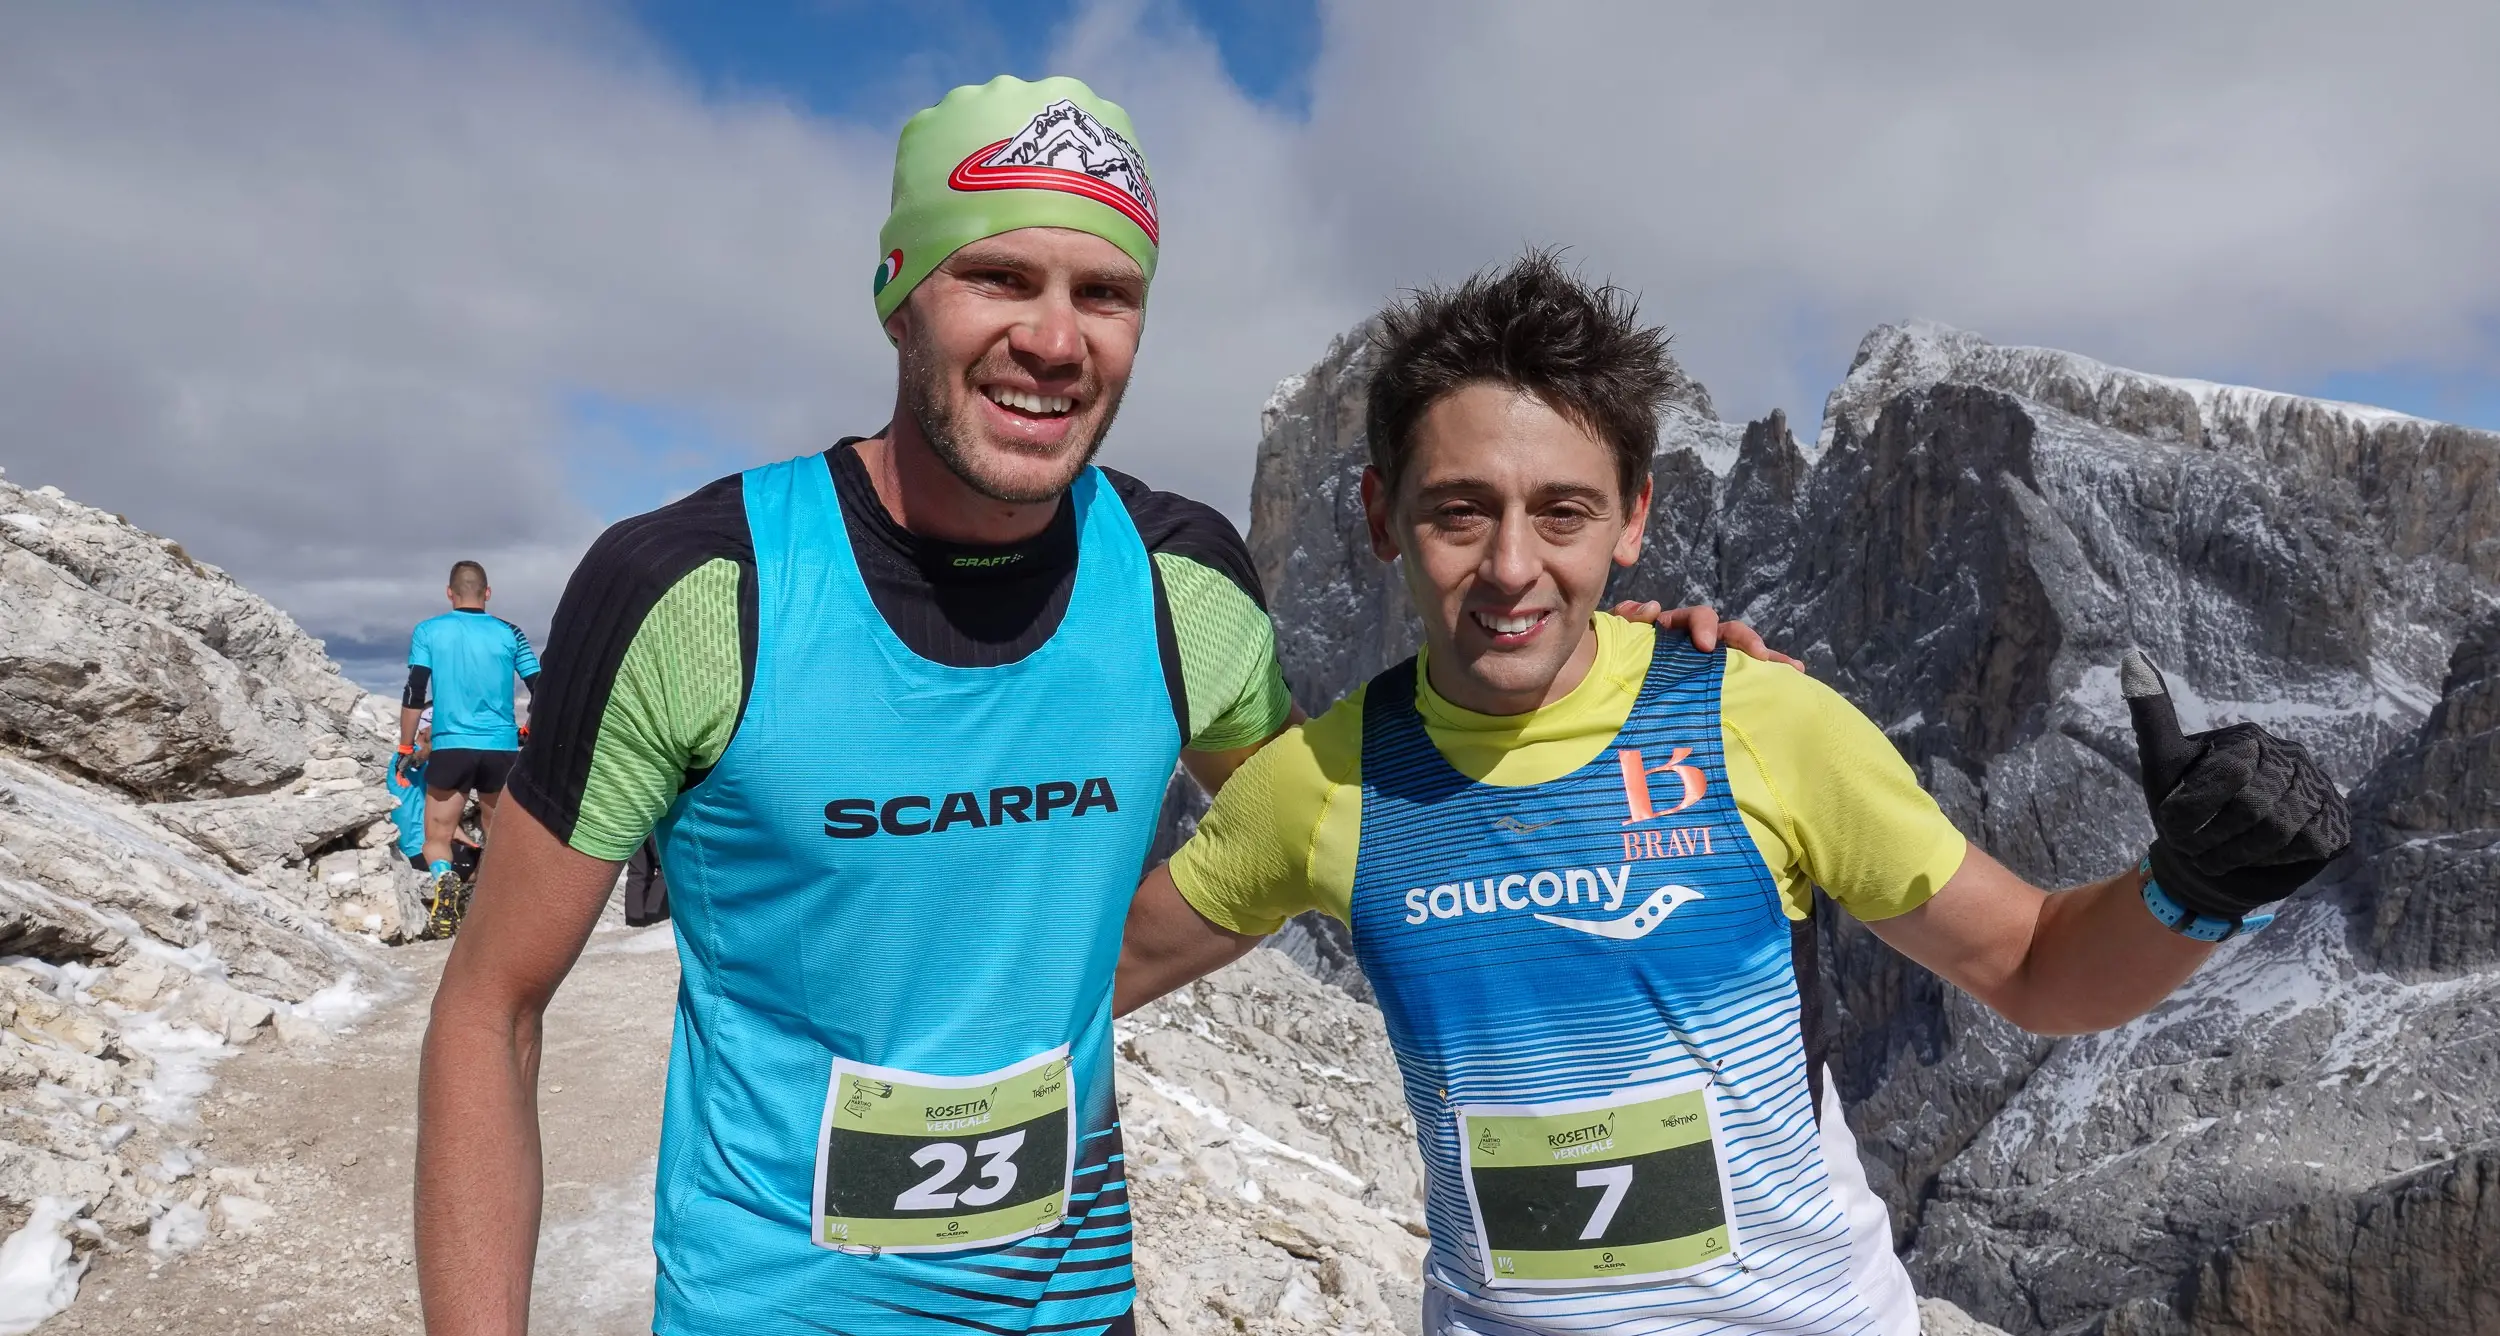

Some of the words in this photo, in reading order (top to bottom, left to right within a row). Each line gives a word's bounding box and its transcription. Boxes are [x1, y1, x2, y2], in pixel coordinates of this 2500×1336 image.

[1125, 174, 1148, 208] VCO
[952, 554, 1011, 567] CRAFT
[824, 777, 1119, 839] SCARPA
[1620, 826, 1716, 861] BRAVI
[1405, 864, 1632, 925] saucony
[1032, 1082, 1061, 1098] TRENTINO
[925, 1099, 989, 1118] ROSETTA
[926, 1112, 992, 1132] VERTICALE
[1661, 1113, 1698, 1128] TRENTINO
[1547, 1122, 1609, 1147] ROSETTA
[1552, 1138, 1614, 1160] VERTICALE
[893, 1128, 1027, 1211] 23
[1576, 1163, 1634, 1241] 7
[936, 1230, 969, 1238] SCARPA
[1593, 1262, 1626, 1270] SCARPA
